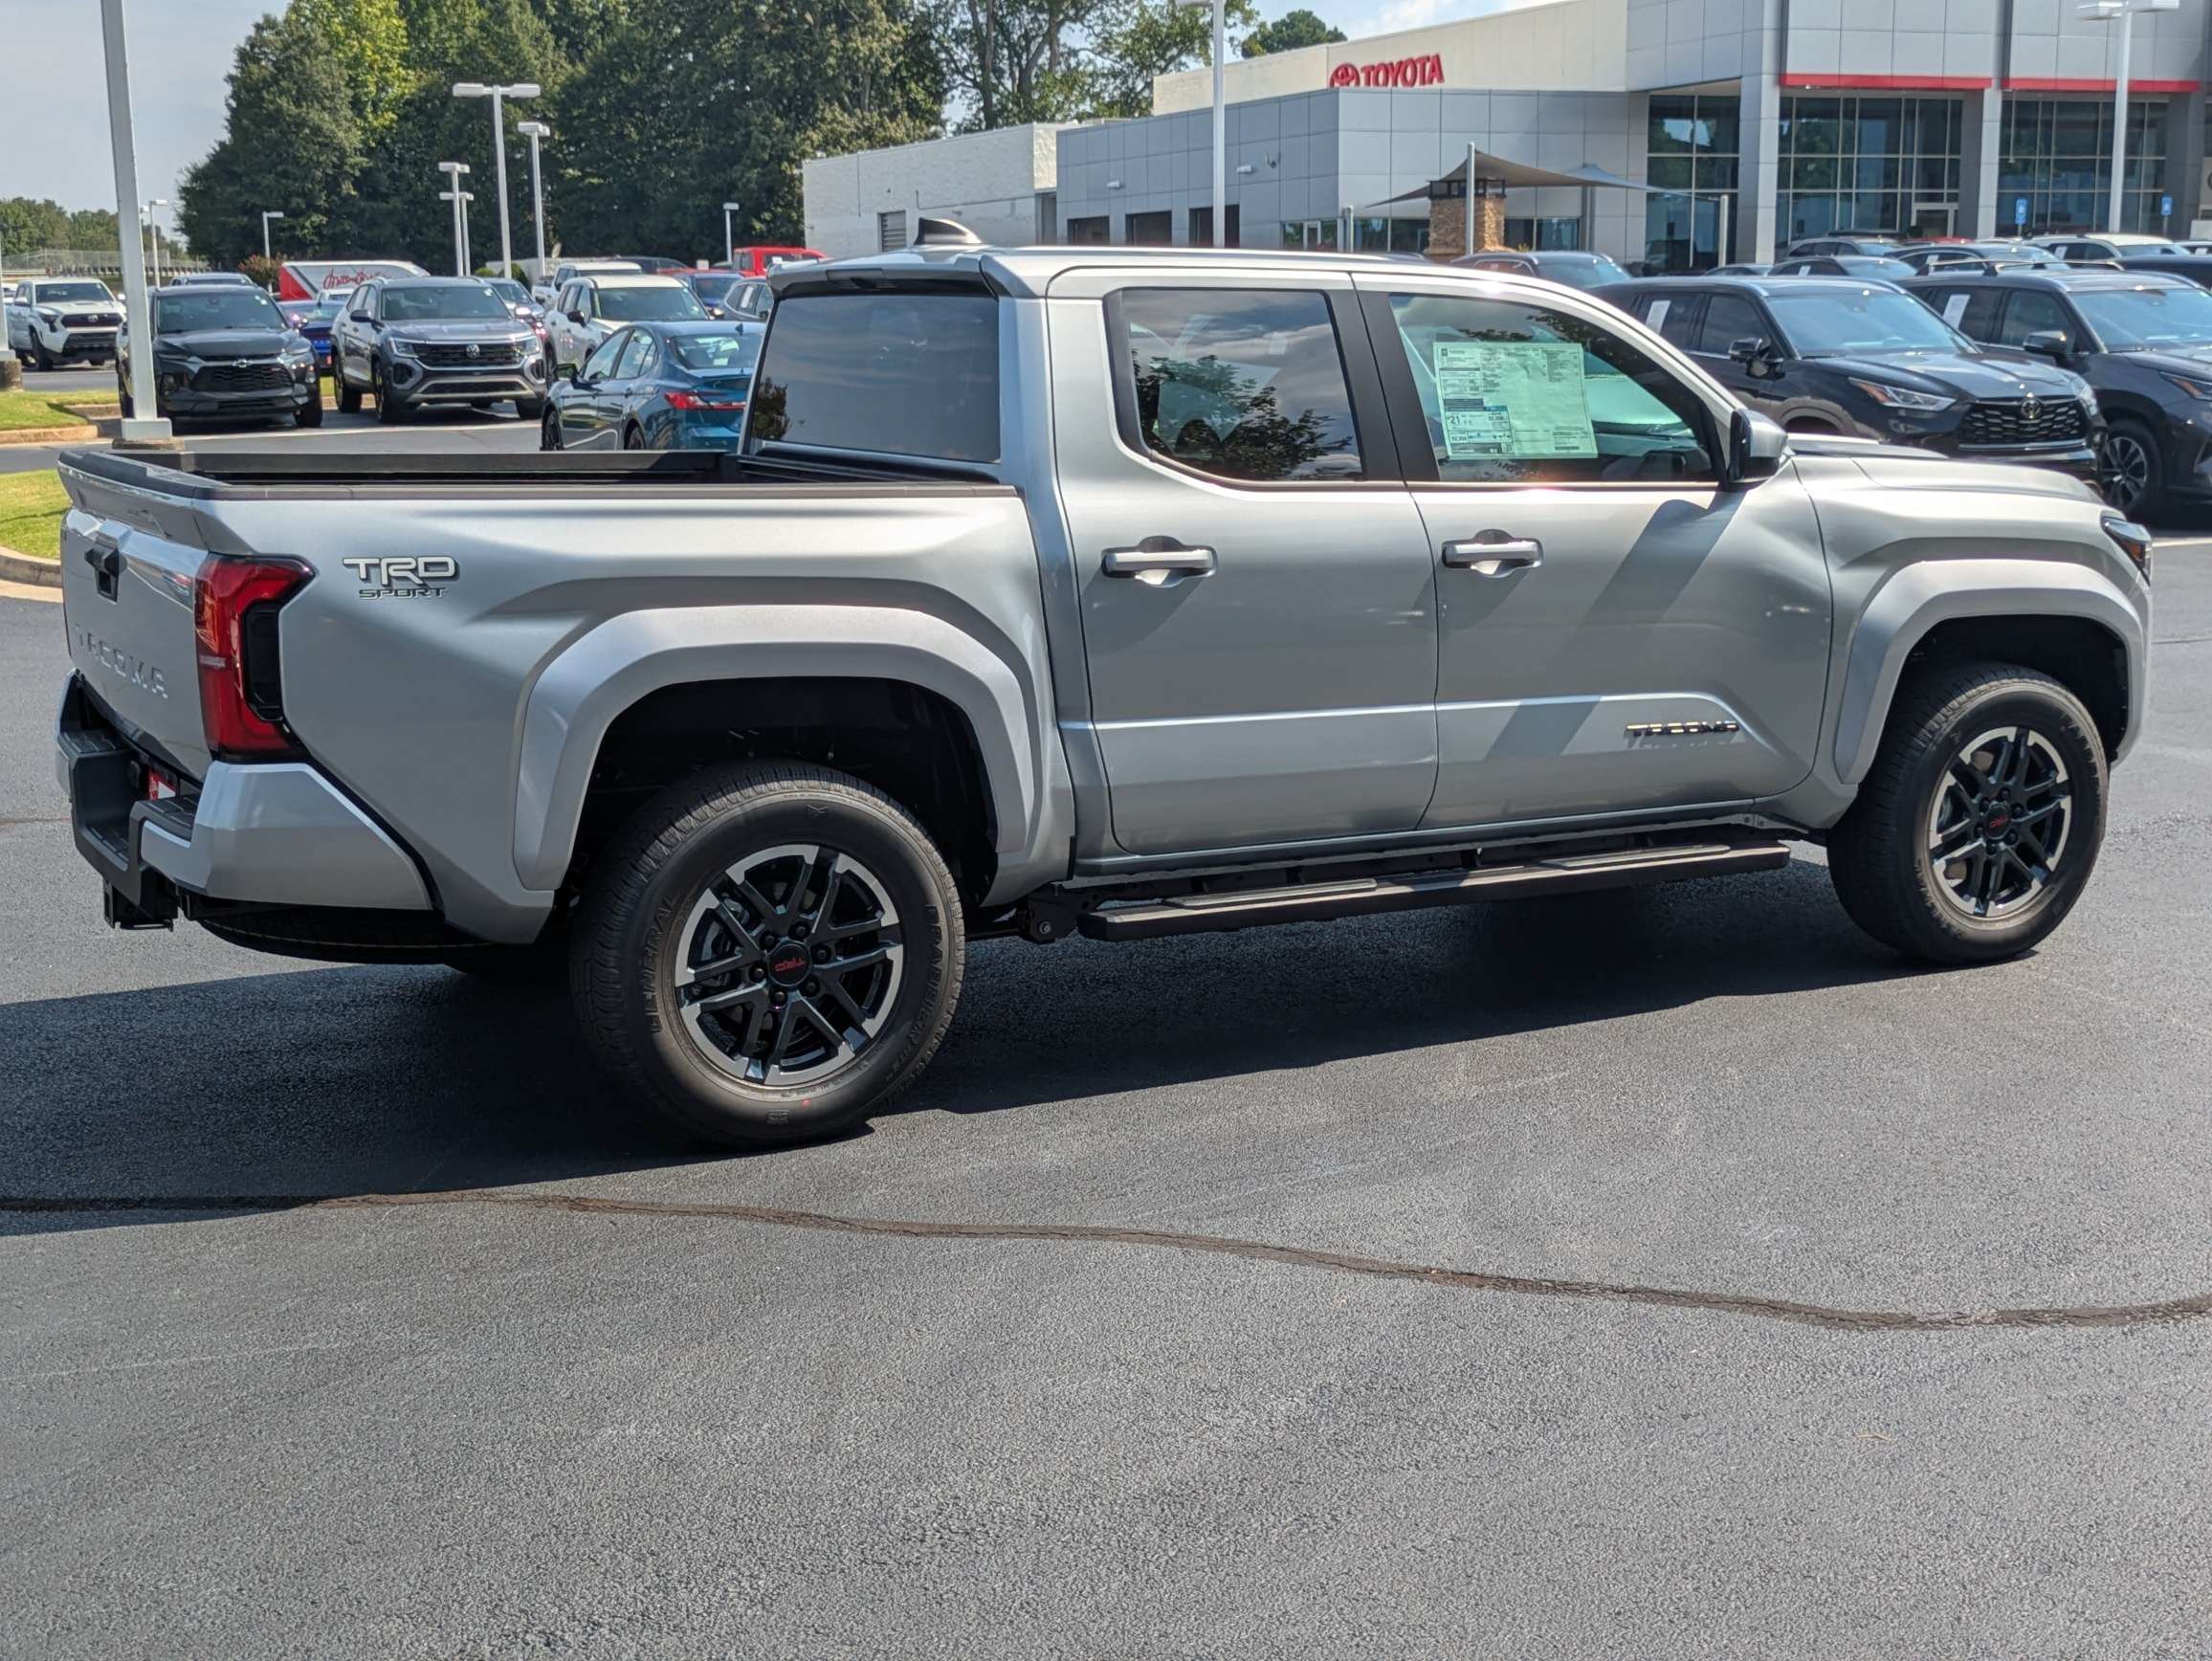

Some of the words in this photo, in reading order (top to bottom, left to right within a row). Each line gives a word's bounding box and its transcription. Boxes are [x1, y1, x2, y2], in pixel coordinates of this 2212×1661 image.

[1360, 54, 1445, 87] TOYOTA
[343, 556, 457, 586] TRD
[358, 587, 448, 600] SPORT
[1626, 720, 1740, 737] TACOMA
